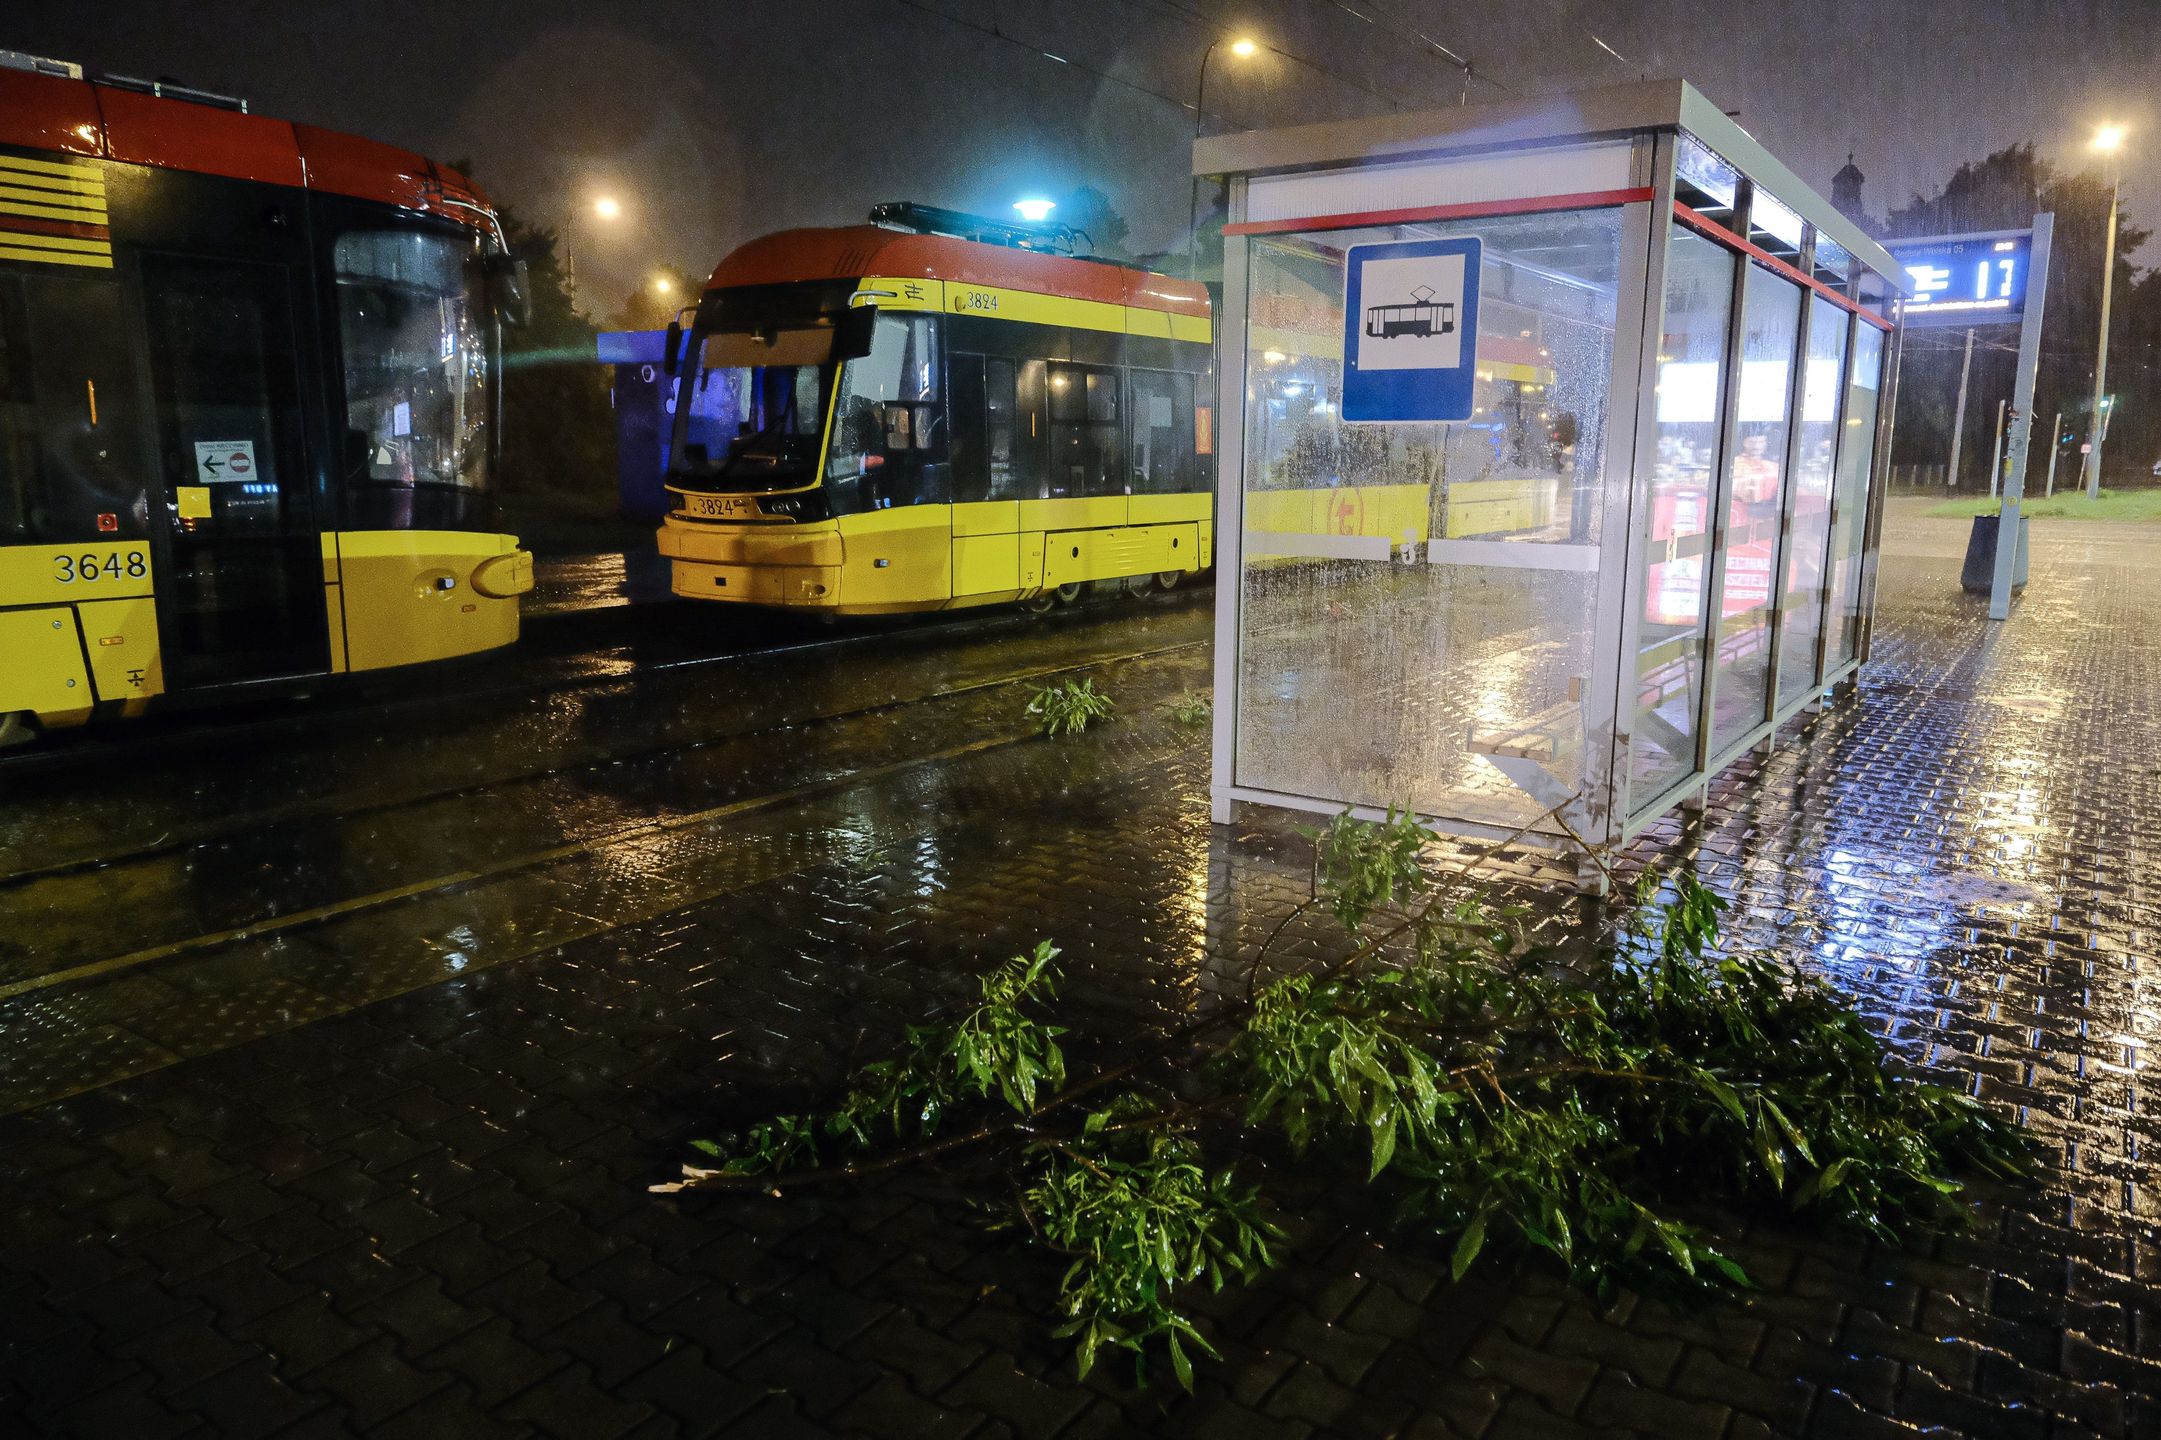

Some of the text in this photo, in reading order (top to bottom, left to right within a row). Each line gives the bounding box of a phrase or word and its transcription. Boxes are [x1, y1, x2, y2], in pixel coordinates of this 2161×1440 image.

[1953, 244, 1964, 254] 05
[967, 291, 998, 311] 3824
[698, 498, 734, 516] 3824
[54, 551, 147, 584] 3648
